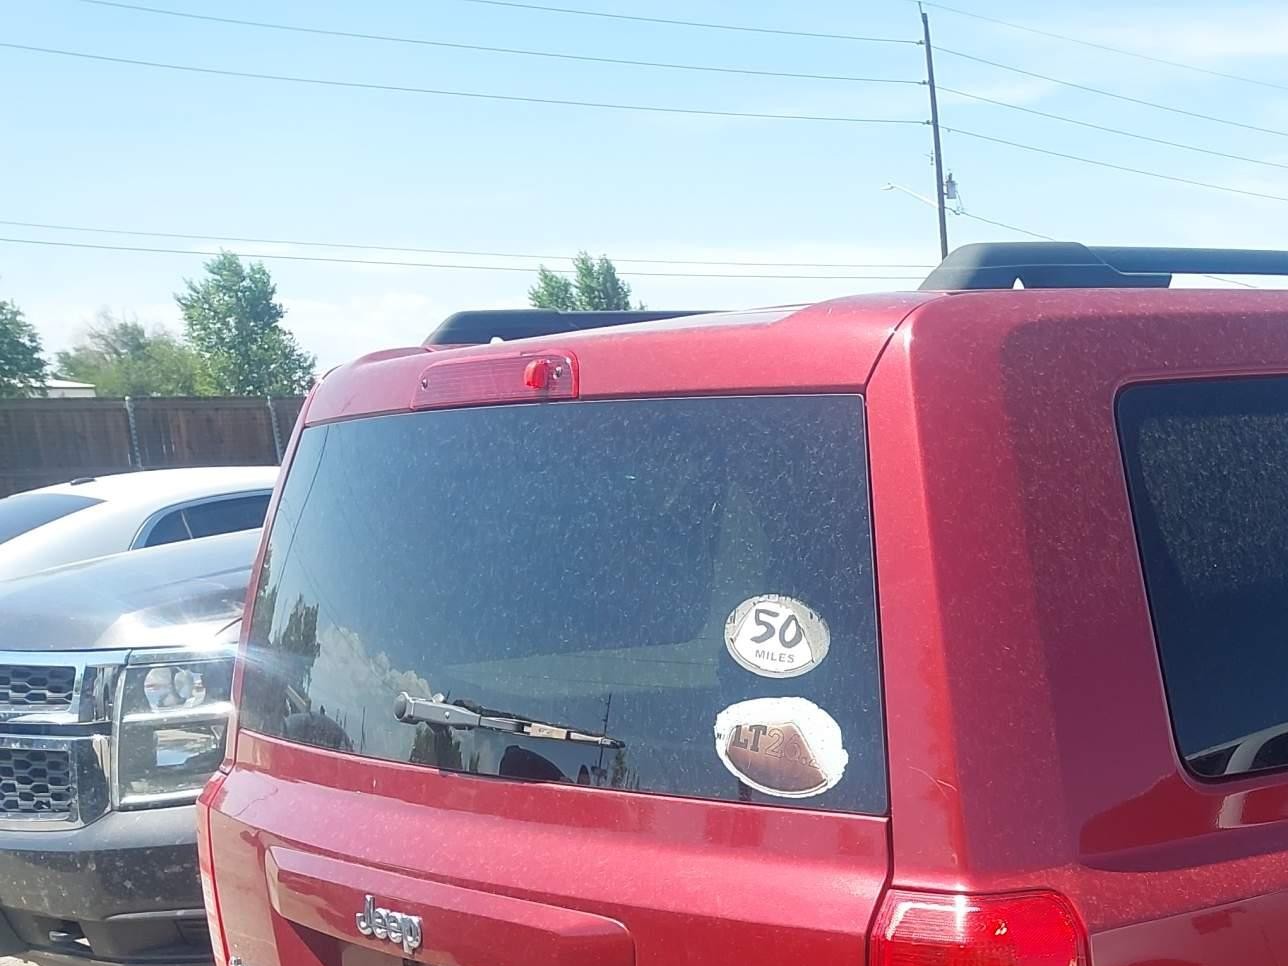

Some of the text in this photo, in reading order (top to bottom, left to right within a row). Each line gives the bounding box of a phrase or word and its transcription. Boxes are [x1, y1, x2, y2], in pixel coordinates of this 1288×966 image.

[750, 608, 803, 649] 50
[755, 649, 796, 664] MILES
[355, 893, 424, 956] Jeep
